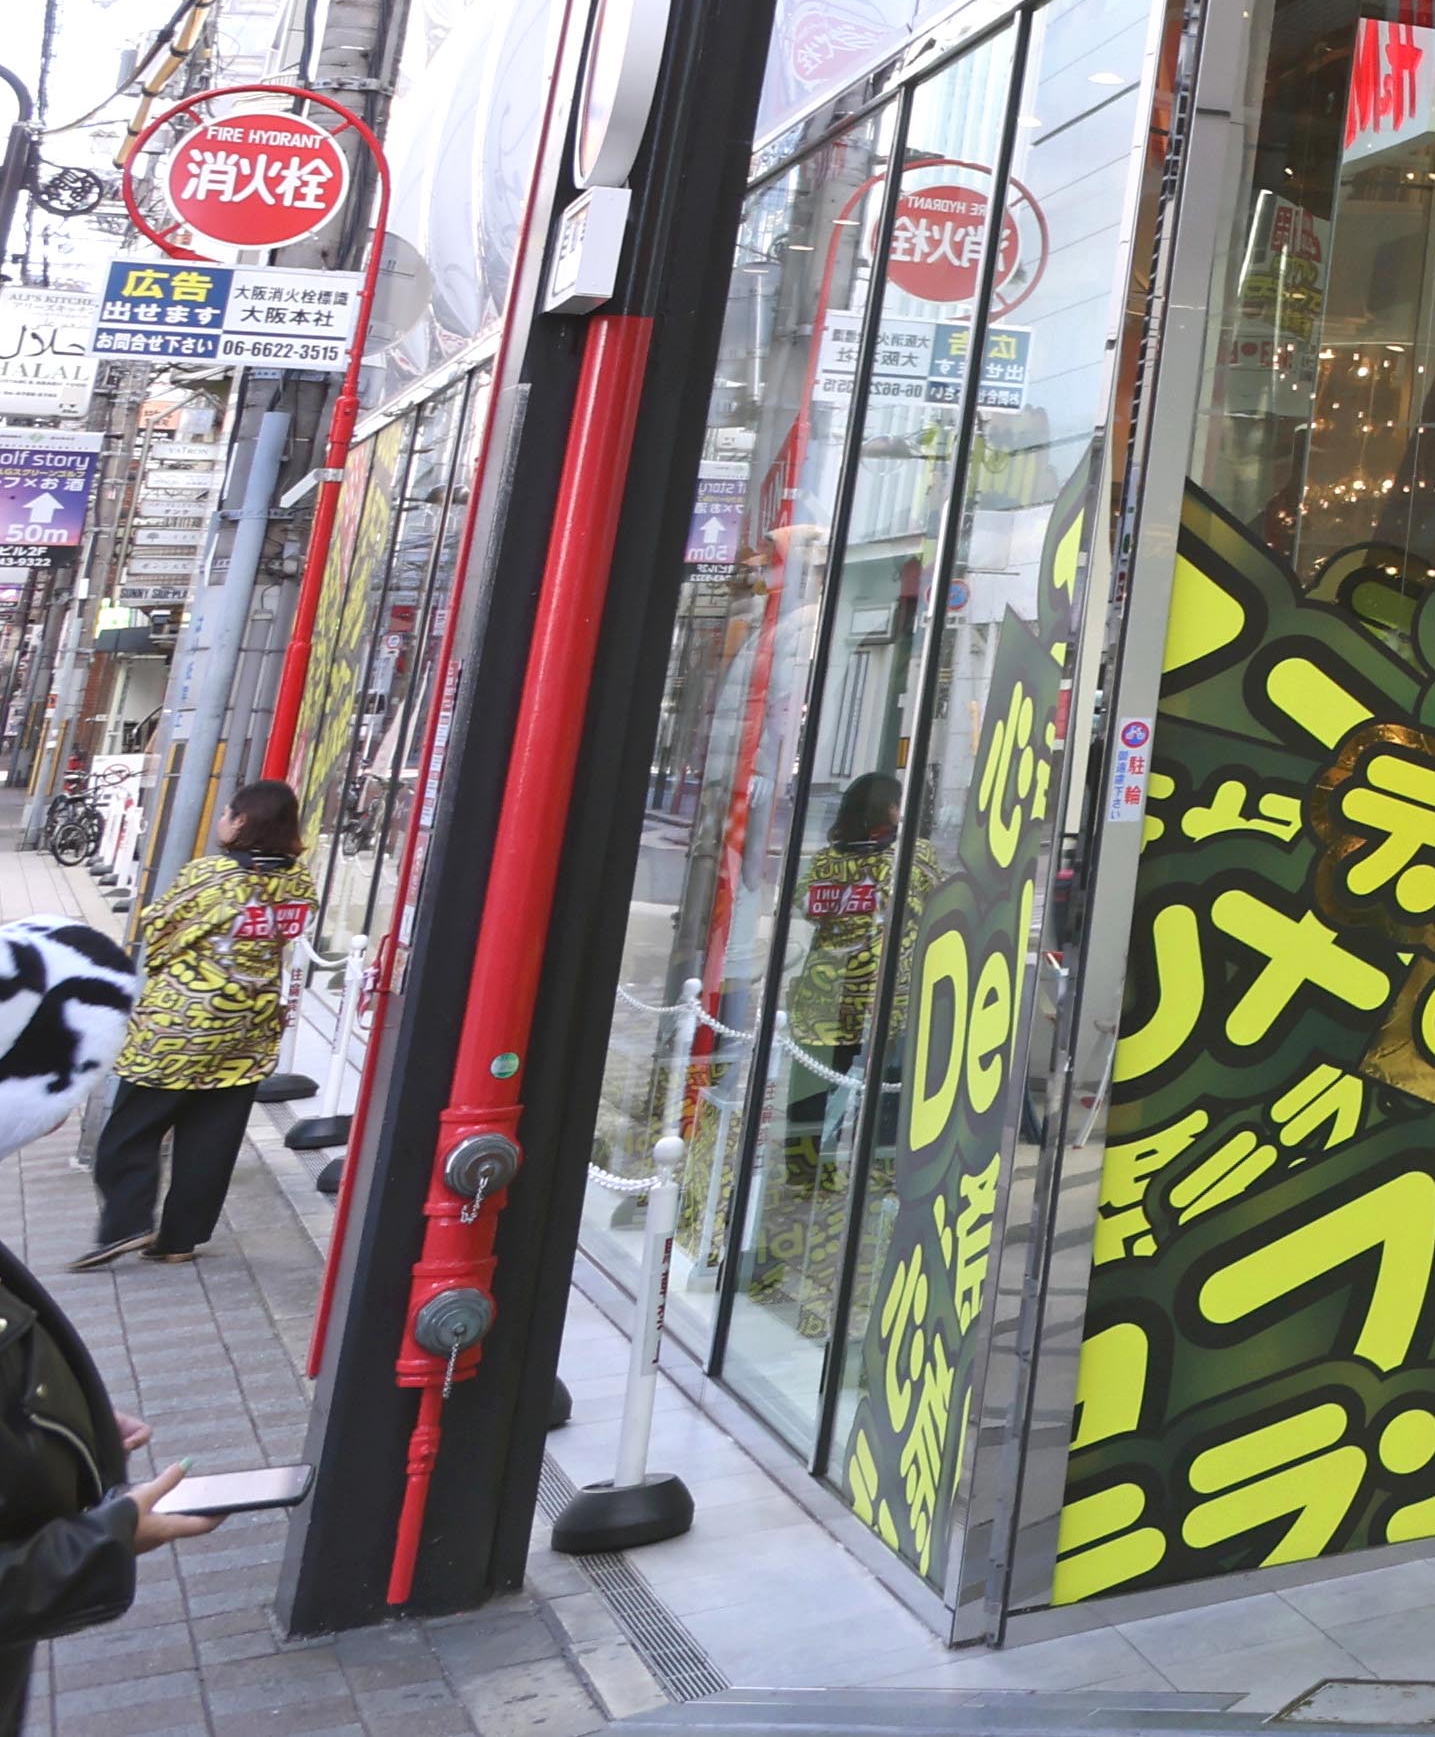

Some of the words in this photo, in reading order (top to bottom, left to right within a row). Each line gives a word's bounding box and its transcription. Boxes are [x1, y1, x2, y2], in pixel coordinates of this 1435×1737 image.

[206, 126, 244, 143] FIRE
[249, 130, 325, 149] HYDRANT
[181, 149, 333, 210] 消火栓
[121, 269, 213, 303] 広告
[234, 284, 349, 306] 大阪消火栓標識
[101, 300, 221, 325] 出せます
[240, 305, 335, 327] 大阪本社
[96, 331, 213, 353] お問合せ下さい
[222, 339, 339, 362] 06-6622-3515
[0, 450, 31, 467] olf
[32, 454, 90, 471] story
[6, 524, 69, 544] 50m
